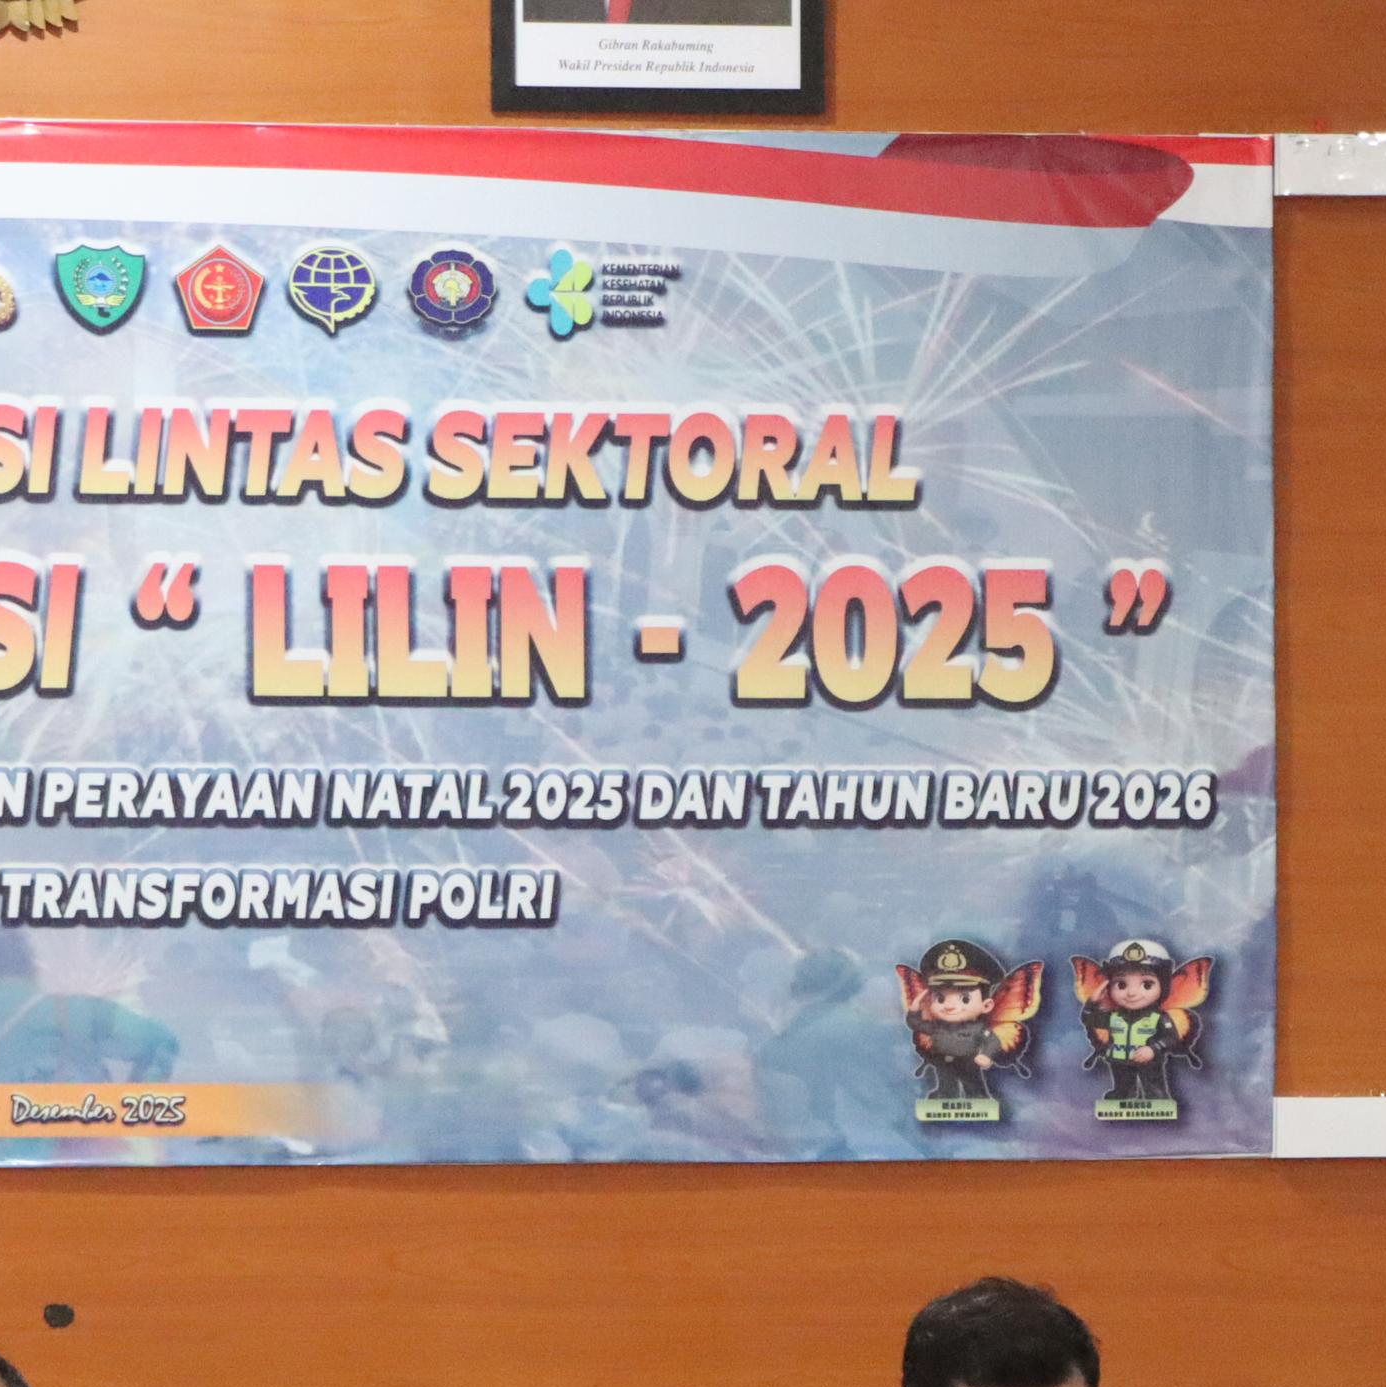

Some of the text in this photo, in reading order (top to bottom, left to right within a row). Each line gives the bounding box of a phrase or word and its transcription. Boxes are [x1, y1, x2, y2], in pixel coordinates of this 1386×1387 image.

[598, 38, 714, 54] Gibran Rakabuming
[558, 59, 755, 75] Wakil Presiden Republik Indonesia
[602, 263, 680, 277] KEMENTERIAN
[602, 279, 666, 292] KESEHATAN
[602, 295, 655, 307] REPUBLIK
[602, 310, 664, 322] INDONESIA
[79, 407, 408, 499] LINTAS
[424, 411, 921, 502] SEKTORAL
[251, 563, 588, 700] LILIN
[639, 625, 681, 655] -
[733, 564, 1056, 703] 2025
[42, 772, 315, 820] PERAYAAN
[330, 773, 495, 820] NATAL
[504, 773, 629, 821] 2025
[638, 774, 751, 821] DAN
[760, 774, 931, 821] TAHUN
[943, 775, 1082, 821] BARU
[1093, 774, 1213, 821] 2026
[0, 872, 397, 921] TRANSFORMASI
[410, 872, 558, 921] POLRI
[12, 1093, 116, 1124] Desember
[121, 1095, 187, 1124] 2025
